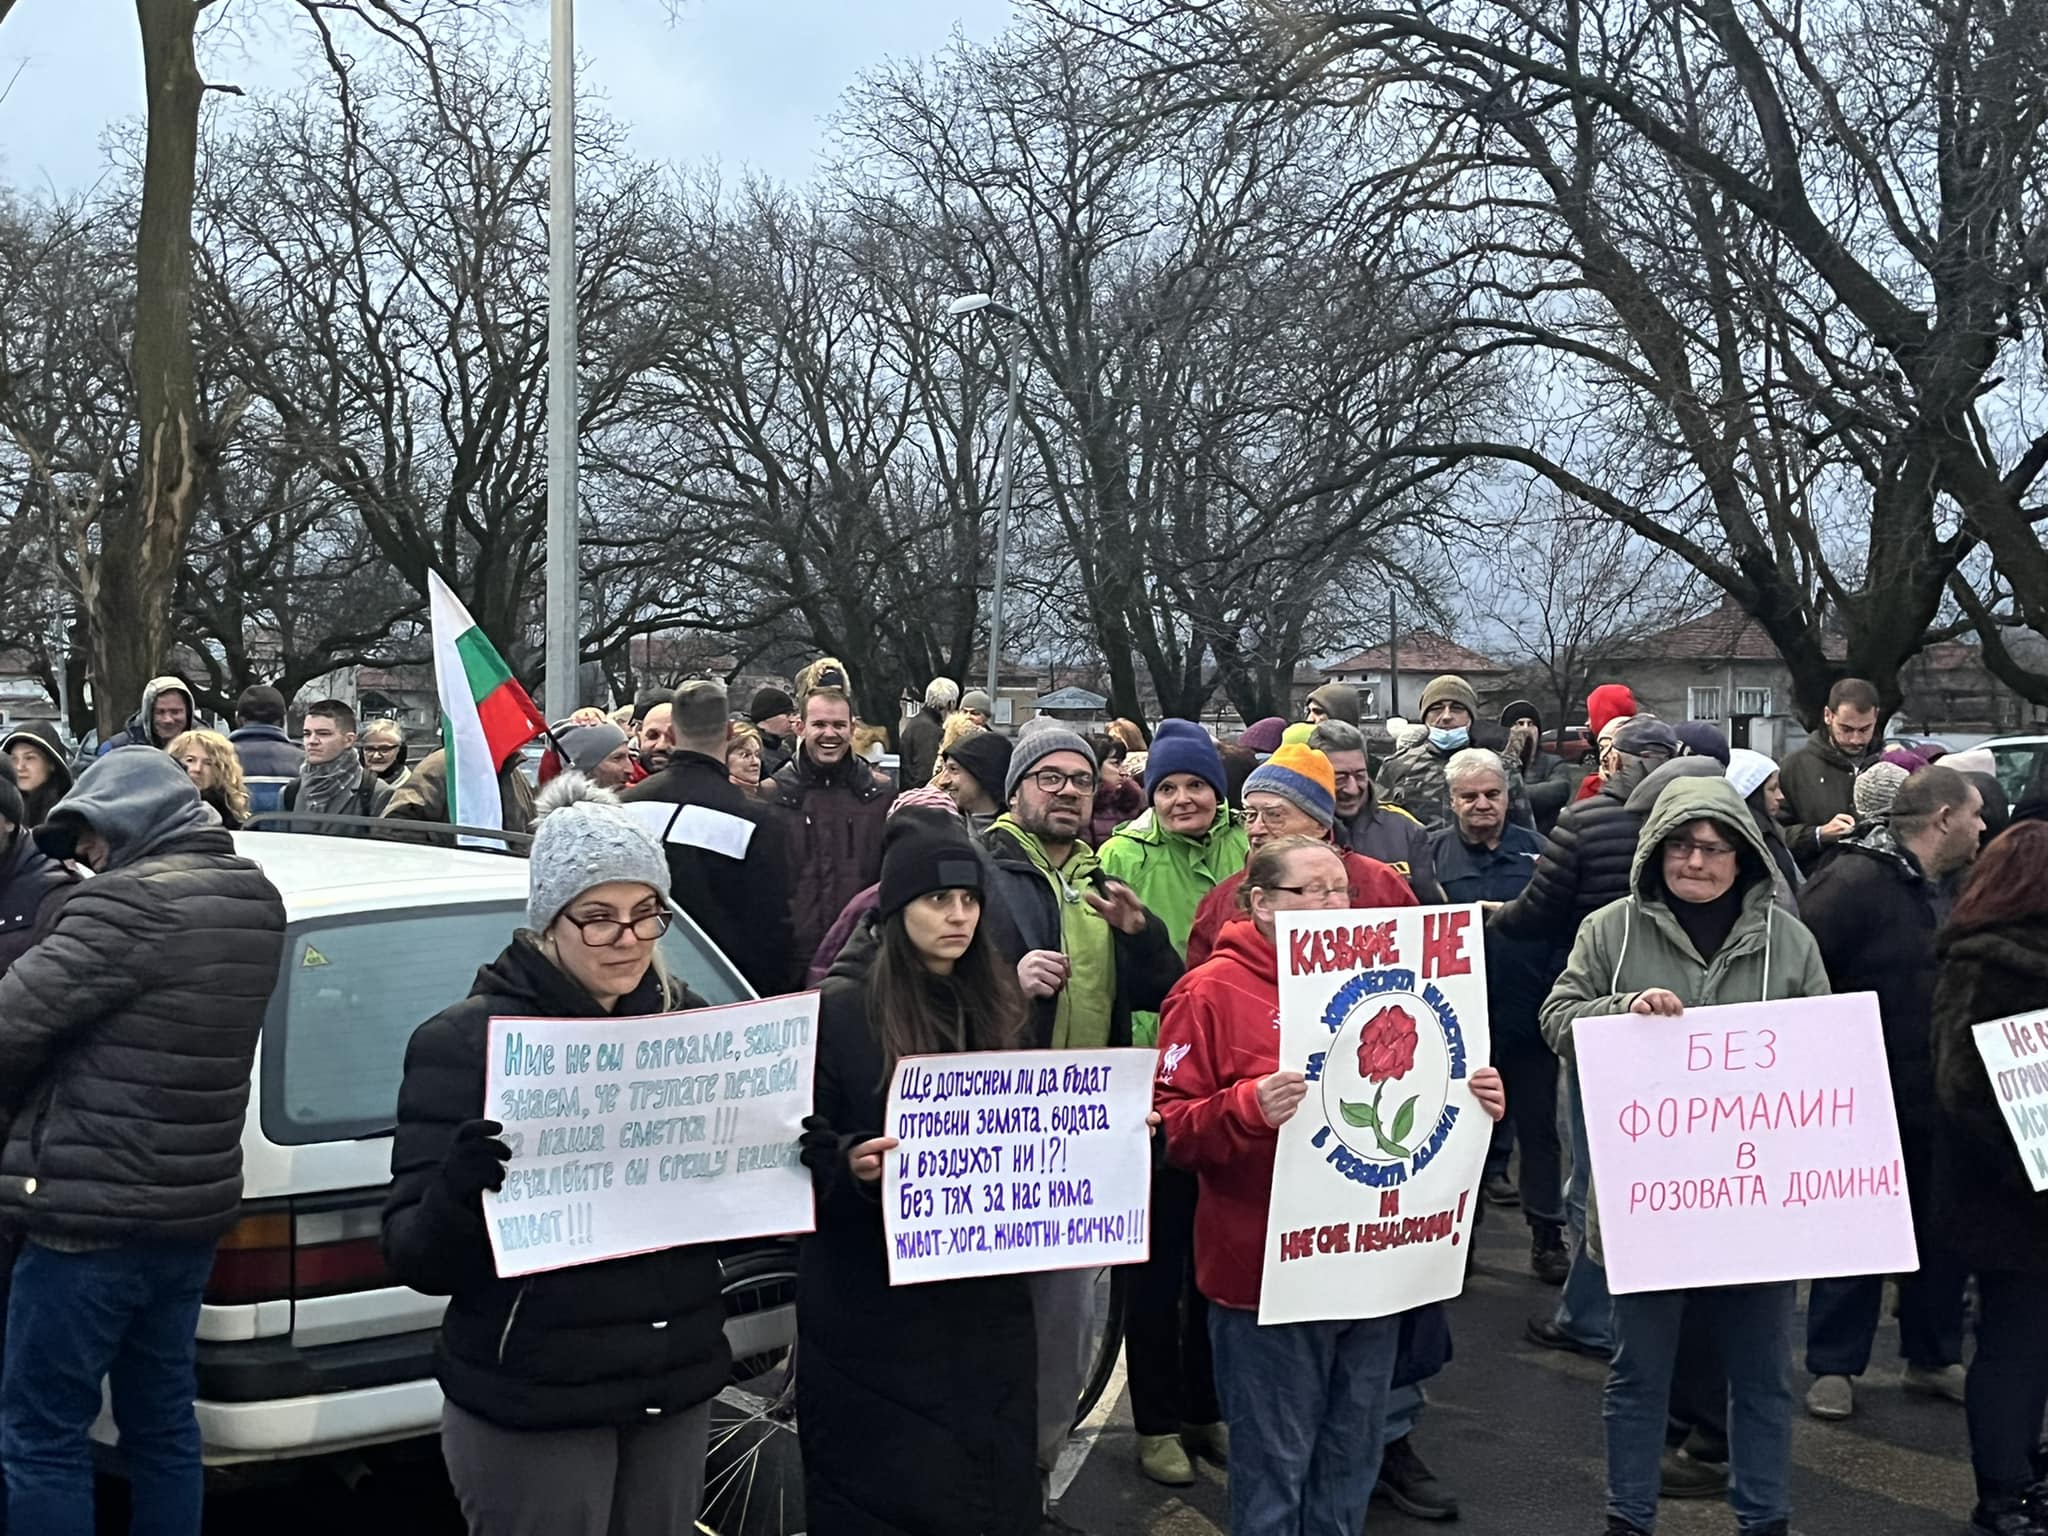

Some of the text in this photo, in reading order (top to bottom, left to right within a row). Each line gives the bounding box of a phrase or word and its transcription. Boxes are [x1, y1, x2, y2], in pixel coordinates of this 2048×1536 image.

[1289, 910, 1471, 979] КАЗВАМЕ НЕ
[504, 1016, 810, 1076] Ние не ви вярваме, защото
[1687, 1029, 1777, 1071] БЕЗ
[2001, 1021, 2038, 1058] Не
[900, 1064, 1111, 1103] Ще допуснем ли да бъдат
[1305, 1051, 1326, 1081] НА
[501, 1058, 799, 1121] знаем, че трупате печалби
[899, 1109, 970, 1140] отровени
[1052, 1104, 1110, 1135] водата
[1618, 1087, 1854, 1143] ФОРМАЛИН
[537, 1123, 606, 1157] наша
[1311, 1125, 1331, 1148] В
[1326, 1144, 1408, 1188] РОЗОВАТА
[1736, 1142, 1756, 1170] В
[625, 1158, 649, 1185] ви
[659, 1149, 728, 1180] срещу
[899, 1153, 909, 1179] и
[918, 1146, 1003, 1179] въздухът
[900, 1178, 1094, 1220] Без тях за нас няма
[1379, 1189, 1400, 1218] И
[1630, 1160, 1901, 1214] РОЗОВАТА ДОЛИНА!
[1280, 1227, 1316, 1262] НИЕ
